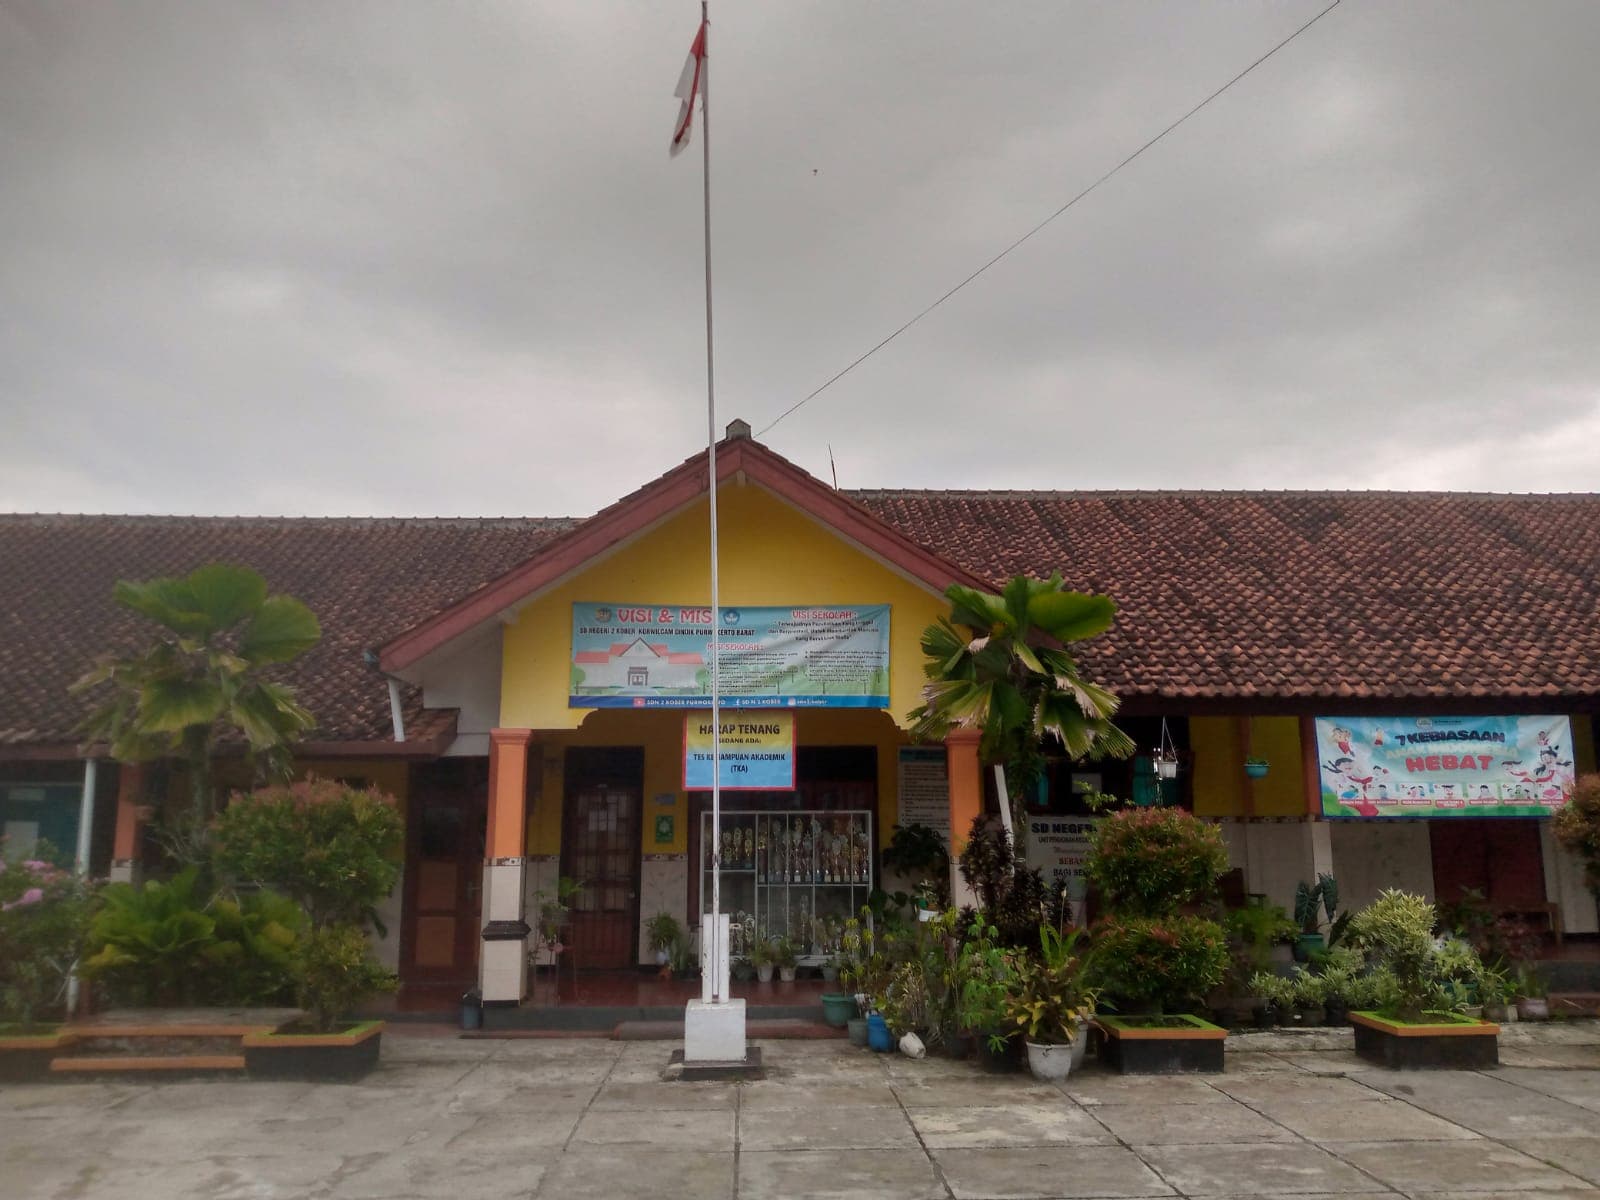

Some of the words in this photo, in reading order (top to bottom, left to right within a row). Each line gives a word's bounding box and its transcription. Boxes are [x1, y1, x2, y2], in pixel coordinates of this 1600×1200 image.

[617, 608, 652, 623] VISI
[658, 608, 674, 623] &
[679, 608, 714, 624] MIS
[812, 610, 852, 619] SEKOLAH
[695, 628, 735, 636] PURWKERTO
[737, 724, 780, 734] TENANG
[1395, 734, 1405, 746] 7
[1406, 730, 1506, 745] KEBIASAAN
[693, 753, 705, 761] TES
[706, 753, 749, 761] KEAMPUAN
[750, 753, 785, 761] AKADEMIK
[730, 764, 748, 773] (TKA)
[1405, 754, 1494, 773] HEBAT
[1031, 822, 1049, 834] SD
